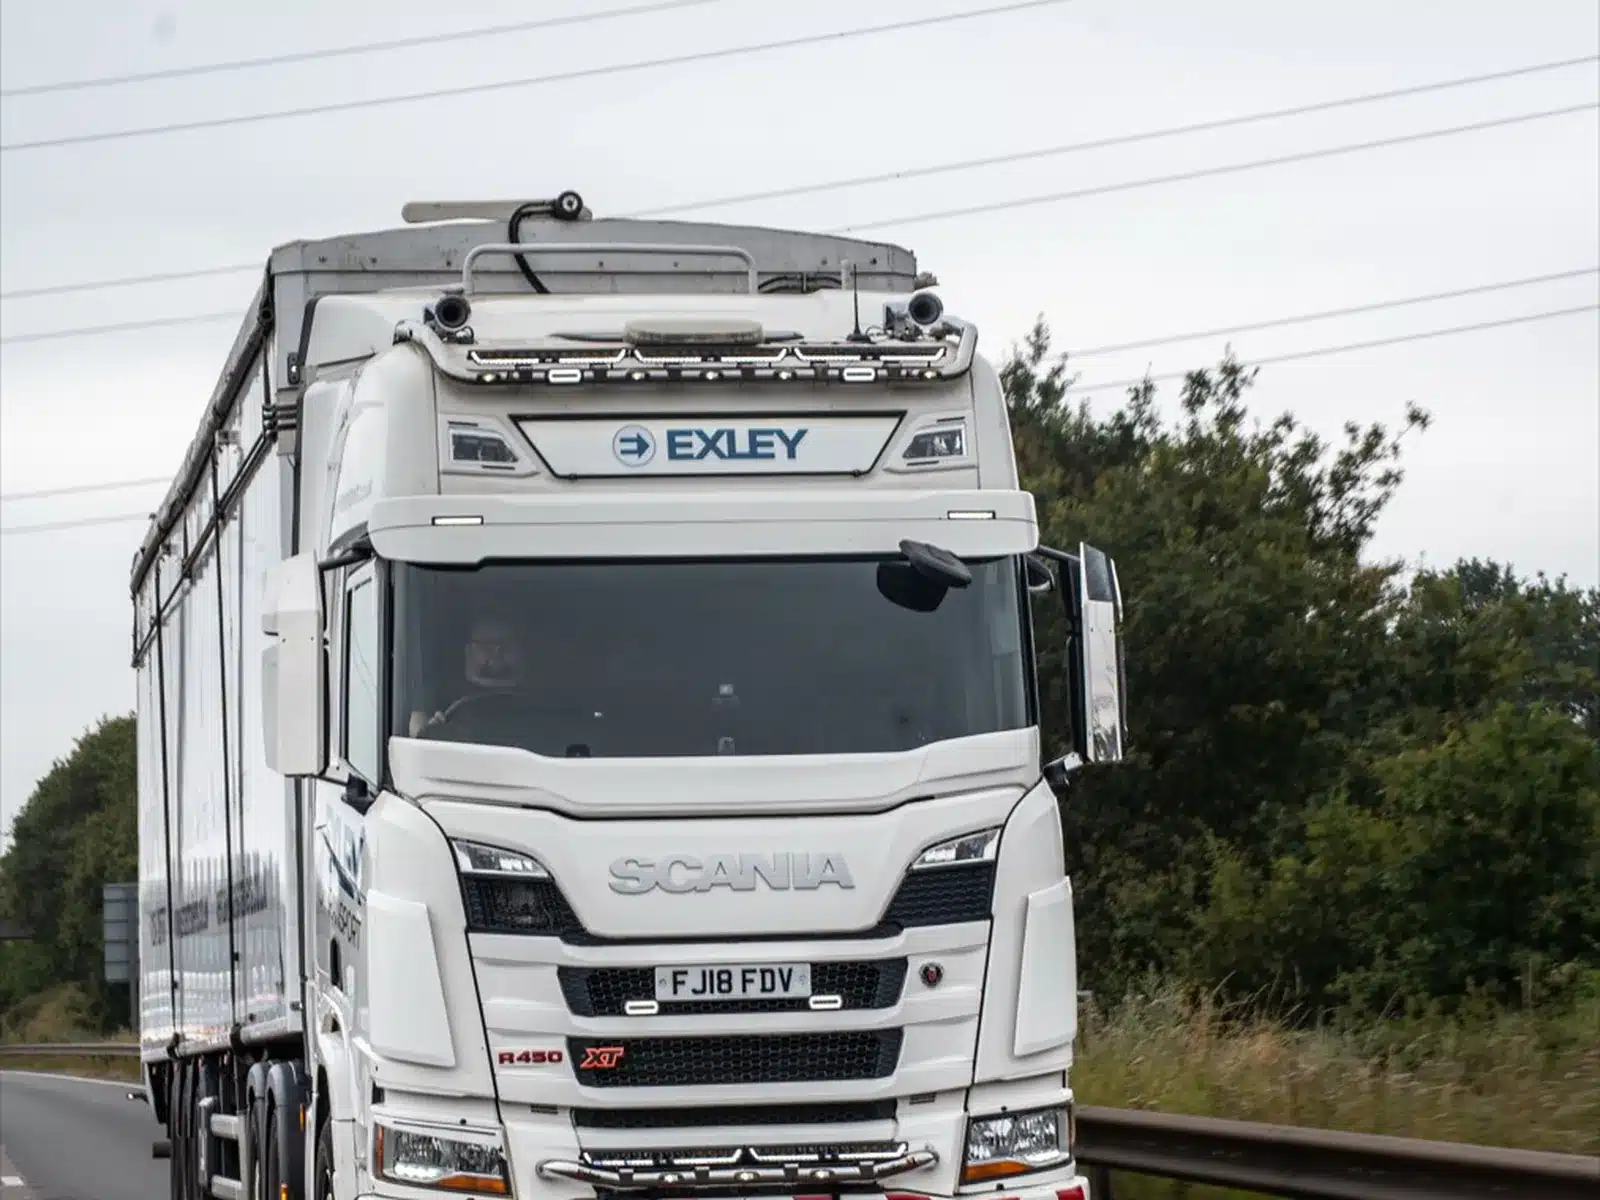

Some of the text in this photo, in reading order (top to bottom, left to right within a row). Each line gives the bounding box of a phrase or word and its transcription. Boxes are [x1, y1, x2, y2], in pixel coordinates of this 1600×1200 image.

[666, 428, 808, 460] EXLEY
[608, 852, 855, 894] SCANIA
[672, 967, 794, 996] FJ18 FDV
[498, 1050, 563, 1065] R450
[580, 1047, 624, 1069] XT
